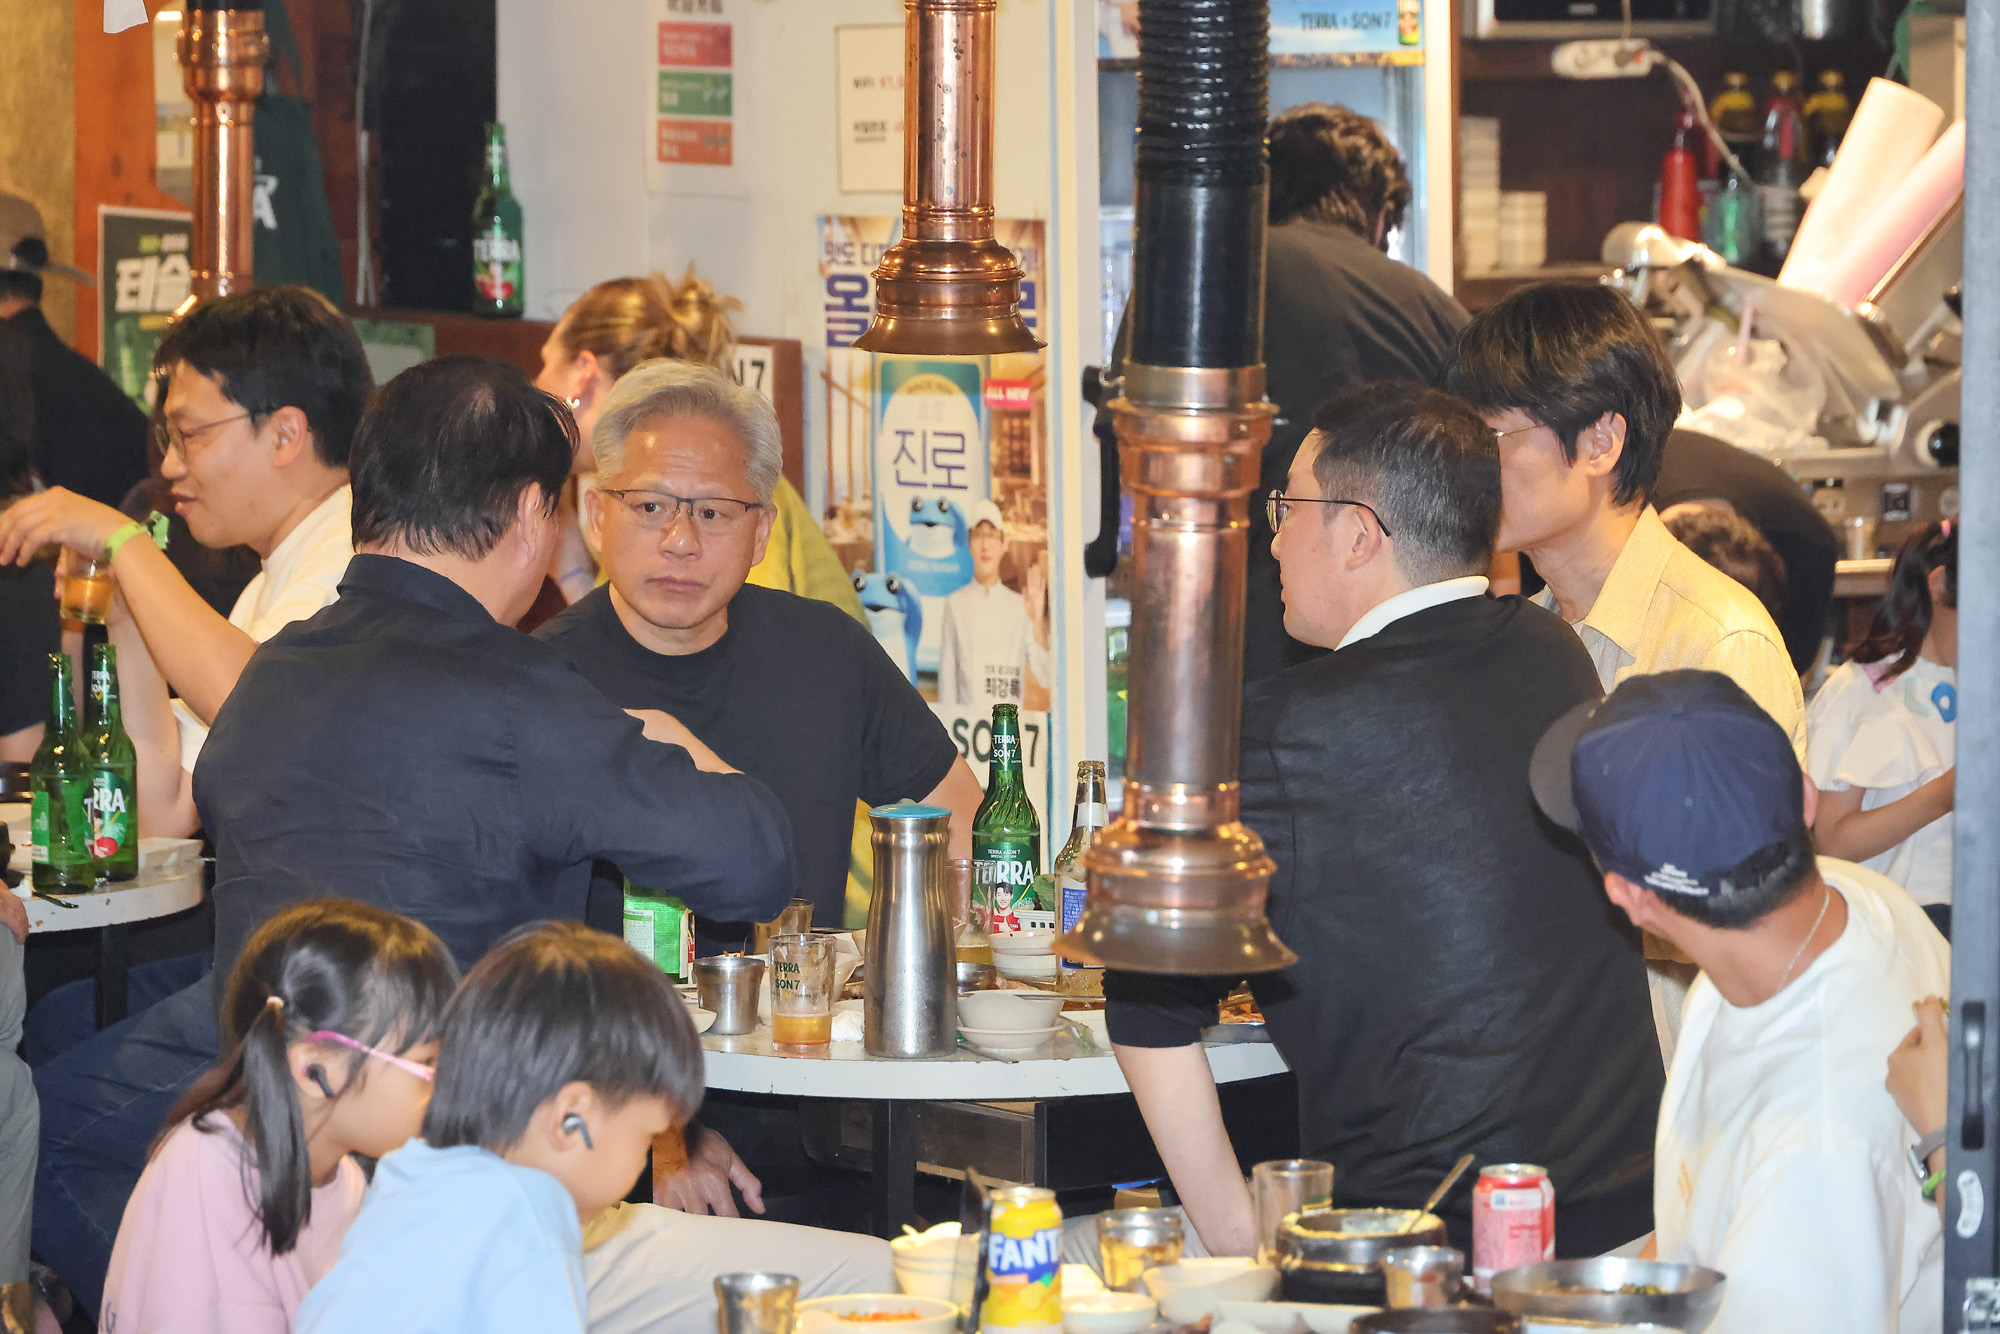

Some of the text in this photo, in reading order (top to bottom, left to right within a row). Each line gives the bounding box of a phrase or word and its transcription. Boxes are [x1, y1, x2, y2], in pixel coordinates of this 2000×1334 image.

[894, 429, 968, 490] 진로
[953, 718, 992, 763] SO
[994, 735, 1016, 745] TERRA
[775, 961, 800, 974] TERRA
